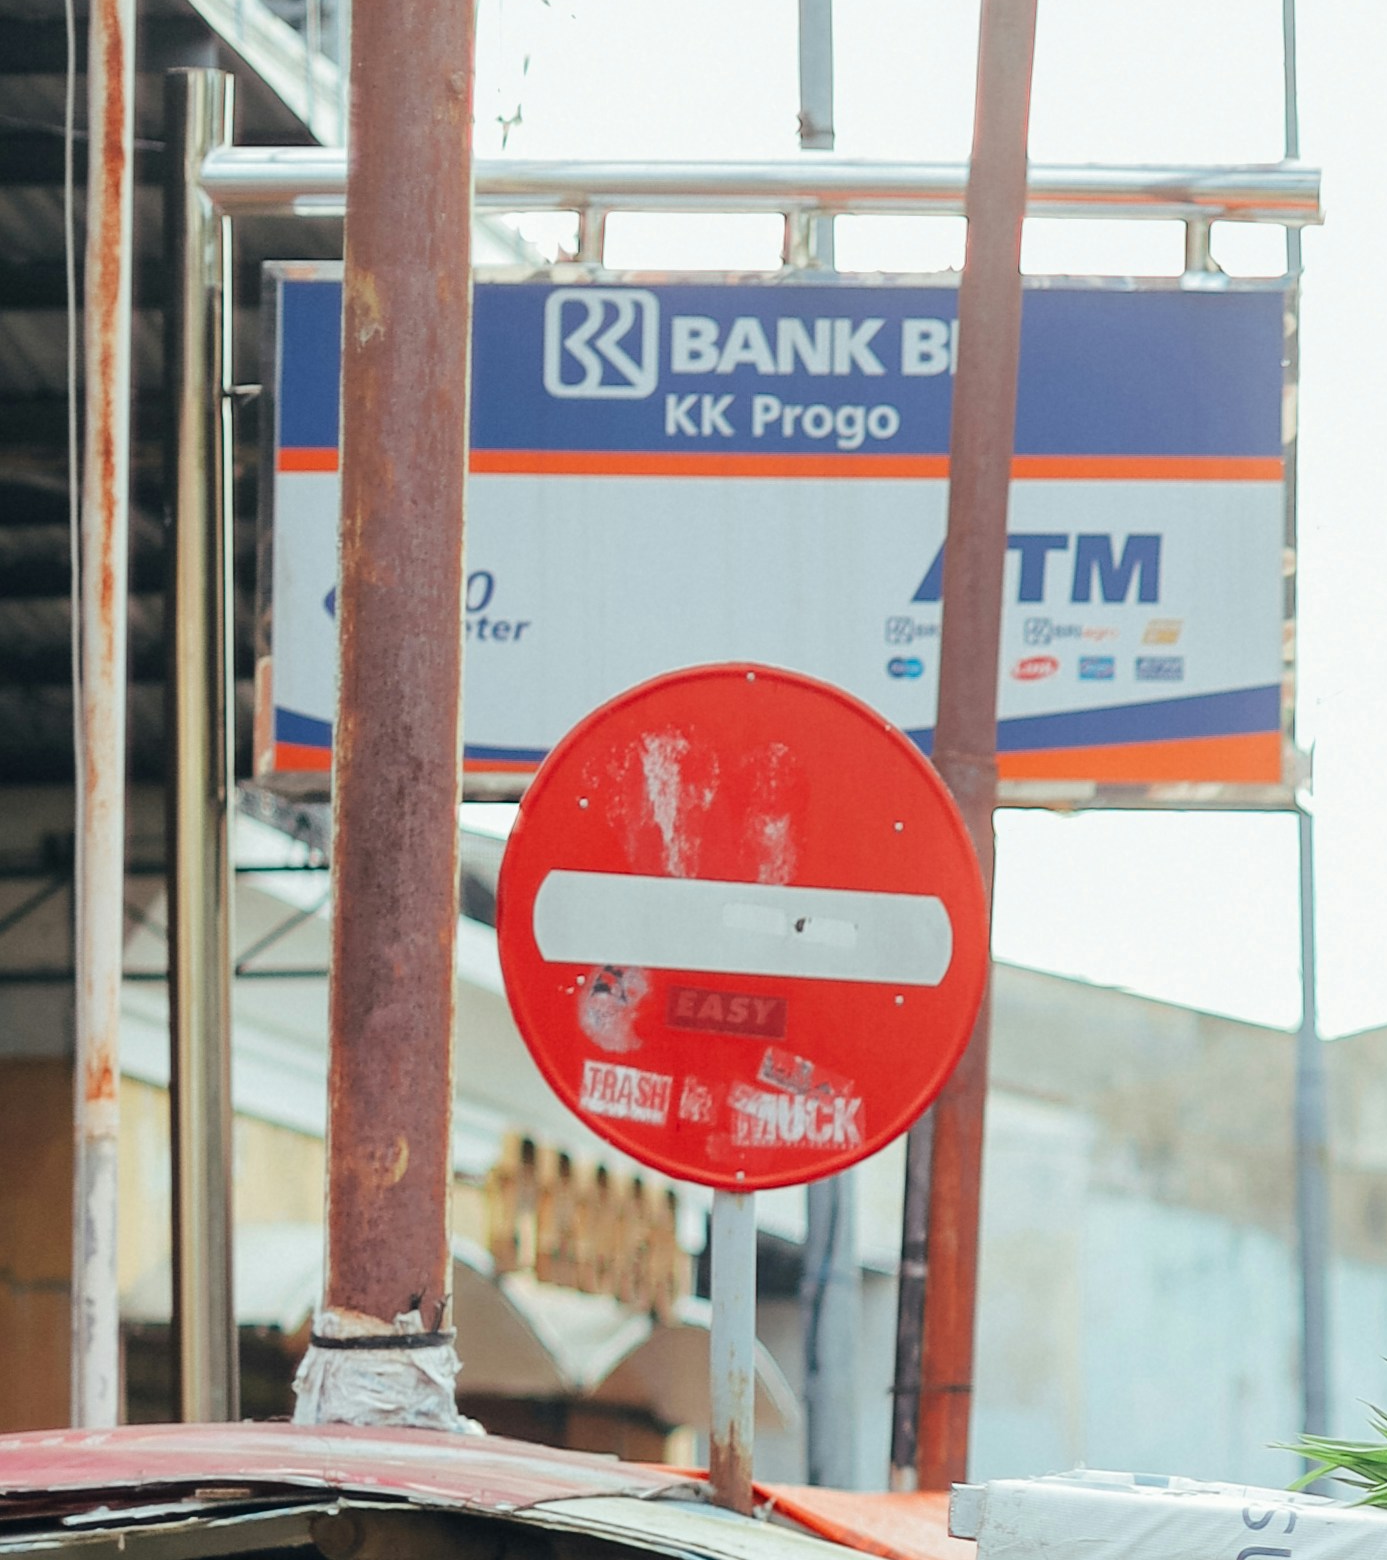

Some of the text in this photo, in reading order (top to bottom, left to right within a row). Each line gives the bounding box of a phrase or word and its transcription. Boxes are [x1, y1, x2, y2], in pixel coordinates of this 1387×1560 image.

[671, 315, 886, 376] BANK
[664, 393, 901, 449] KK Progo
[675, 991, 779, 1025] EASY
[587, 1067, 669, 1113] TRASH
